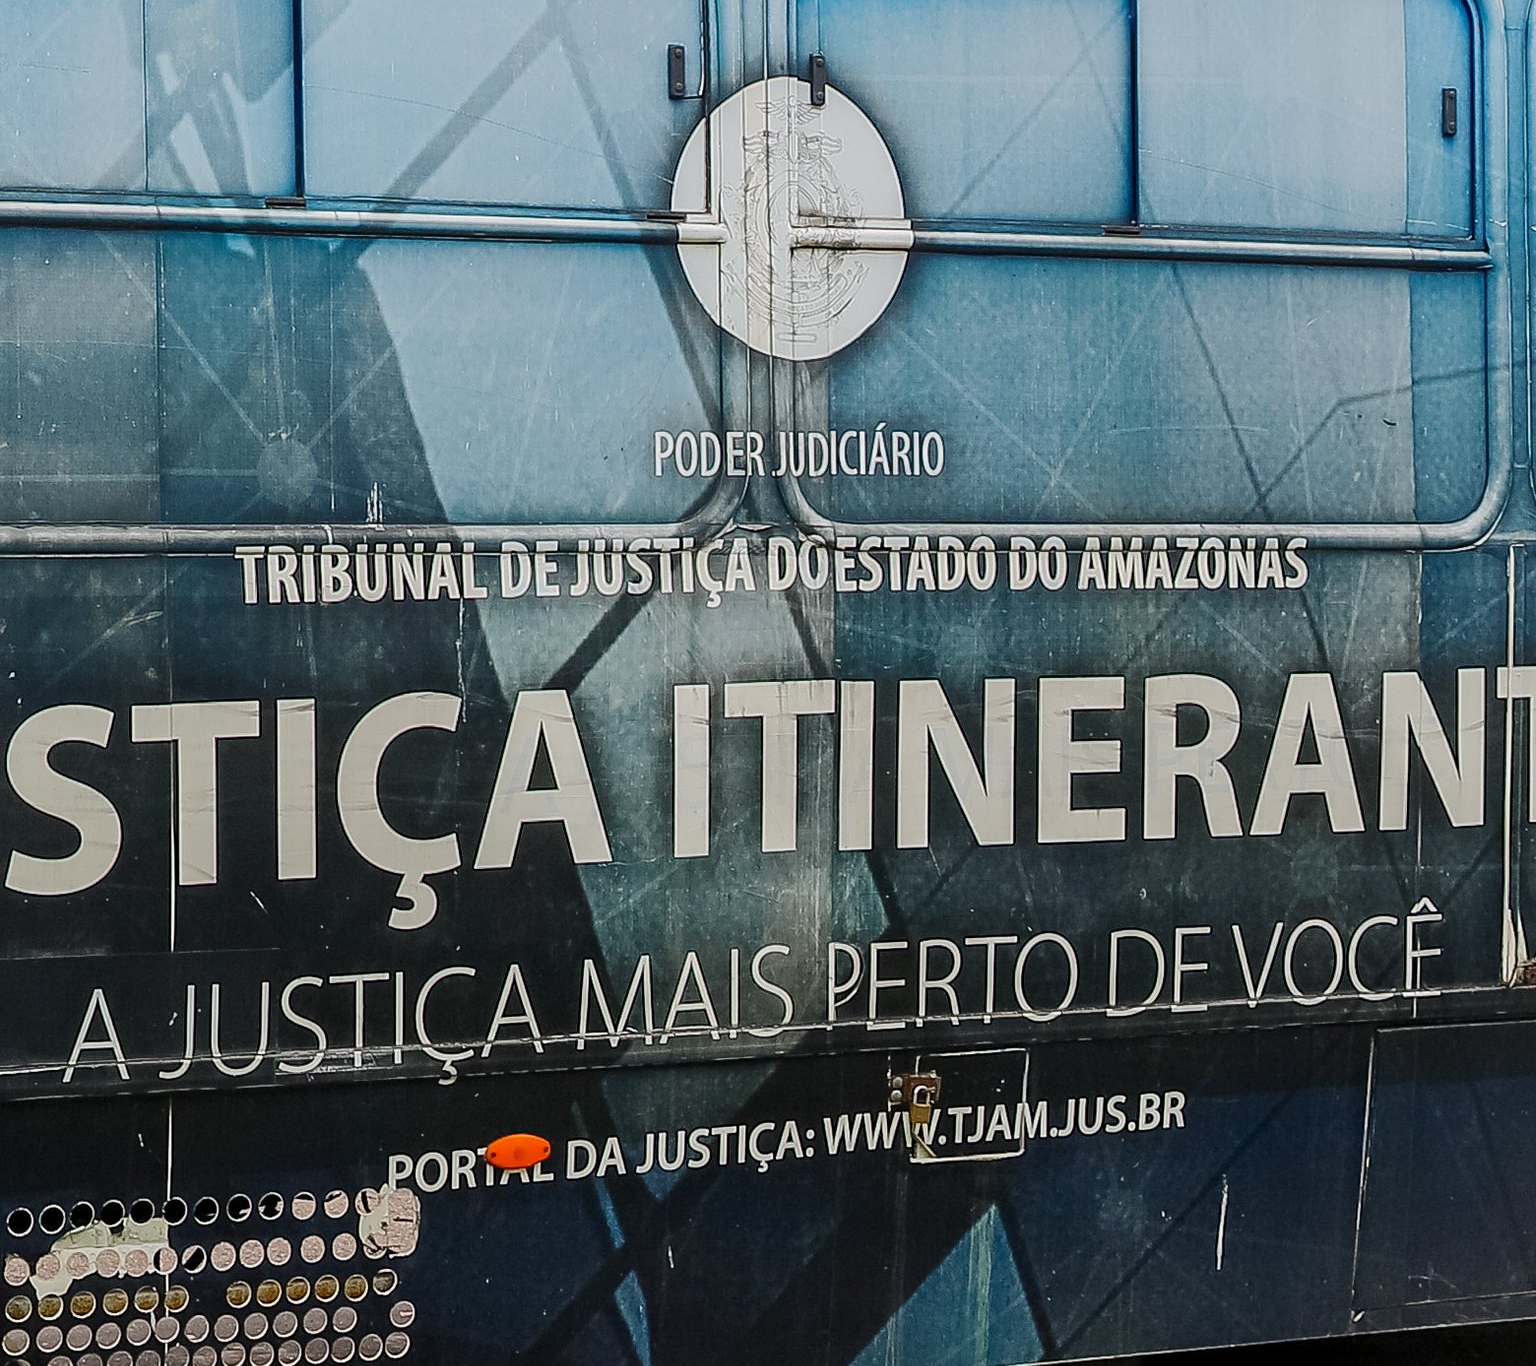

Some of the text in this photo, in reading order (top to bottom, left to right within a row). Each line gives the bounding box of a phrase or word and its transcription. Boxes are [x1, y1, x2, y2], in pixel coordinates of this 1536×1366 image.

[654, 422, 945, 477] PODER JUDICIÁRIO
[234, 542, 487, 604] TRIBUNAL
[500, 540, 561, 598] DE
[570, 537, 756, 608] JUSTIÇA
[1008, 536, 1070, 591] DO
[1078, 536, 1308, 591] AMAZONAS
[63, 897, 1444, 1085] A JUSTIÇA MAIS PERTO DE VOCÊ
[566, 1137, 626, 1180] DA
[636, 1121, 815, 1173] JUSTIÇA:
